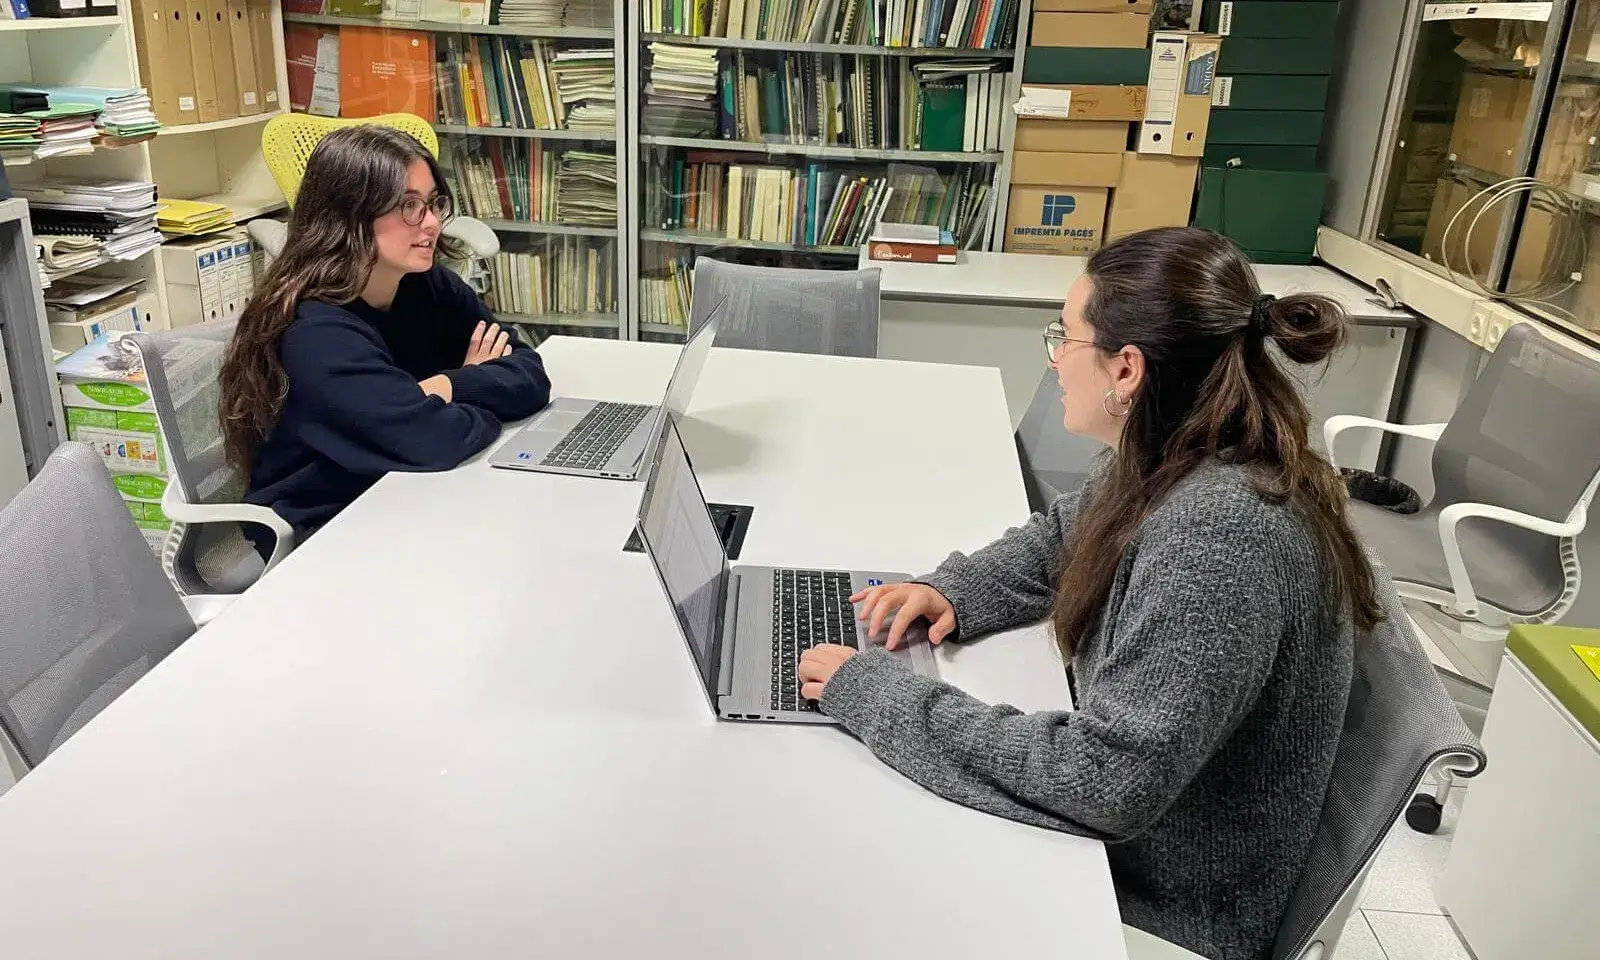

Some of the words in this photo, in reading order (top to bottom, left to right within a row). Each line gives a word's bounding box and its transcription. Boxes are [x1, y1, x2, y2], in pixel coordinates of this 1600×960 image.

[1201, 56, 1214, 95] ONDINA
[1041, 195, 1076, 227] IP
[1014, 227, 1061, 236] IMPREMTA
